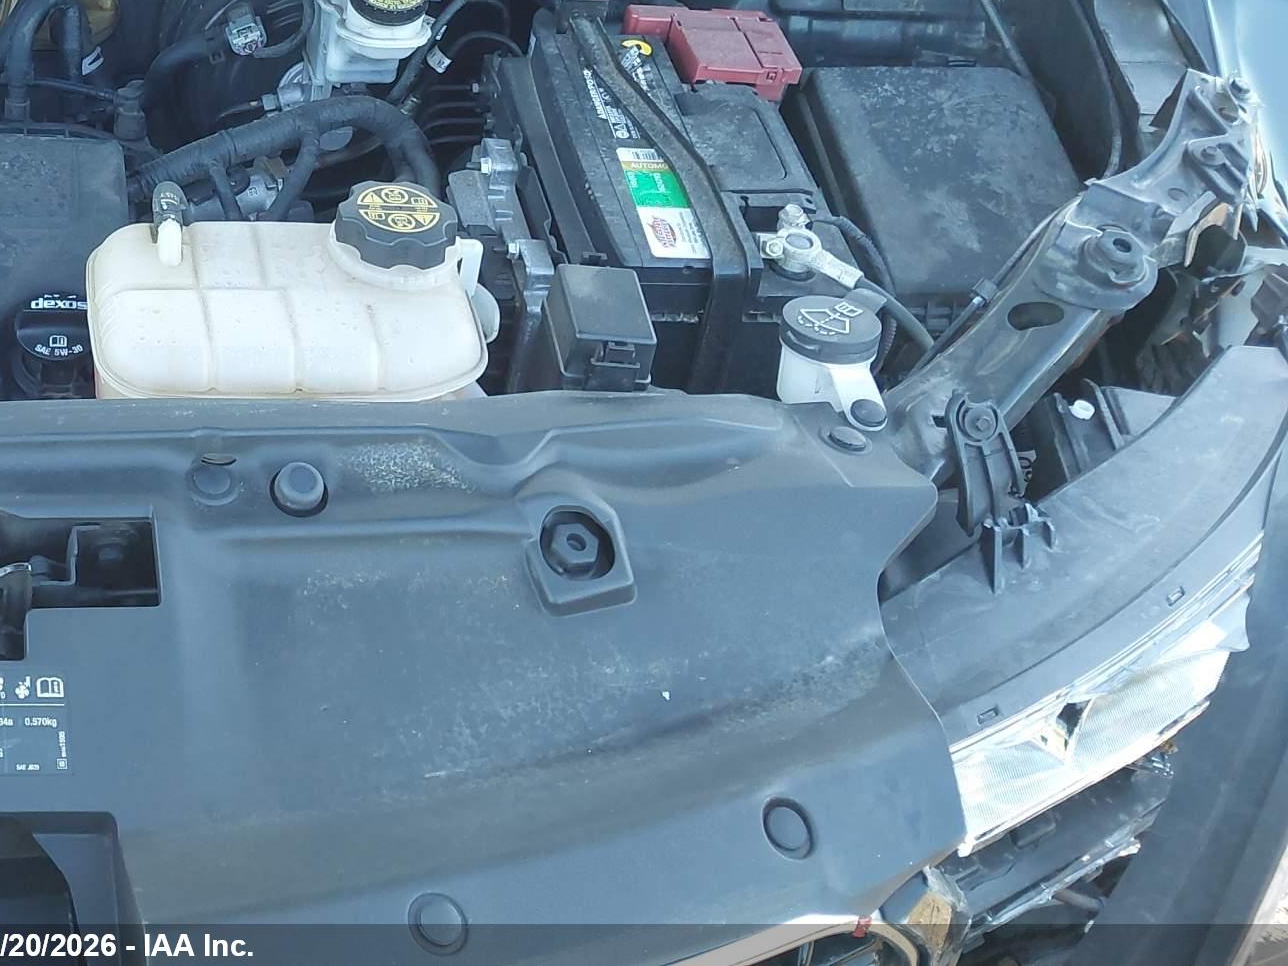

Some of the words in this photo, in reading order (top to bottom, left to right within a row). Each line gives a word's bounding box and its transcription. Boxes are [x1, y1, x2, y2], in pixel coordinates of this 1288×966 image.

[30, 297, 89, 310] dexos
[34, 344, 52, 356] SAE
[54, 344, 84, 356] 5W-30
[24, 718, 57, 728] 0.570kg
